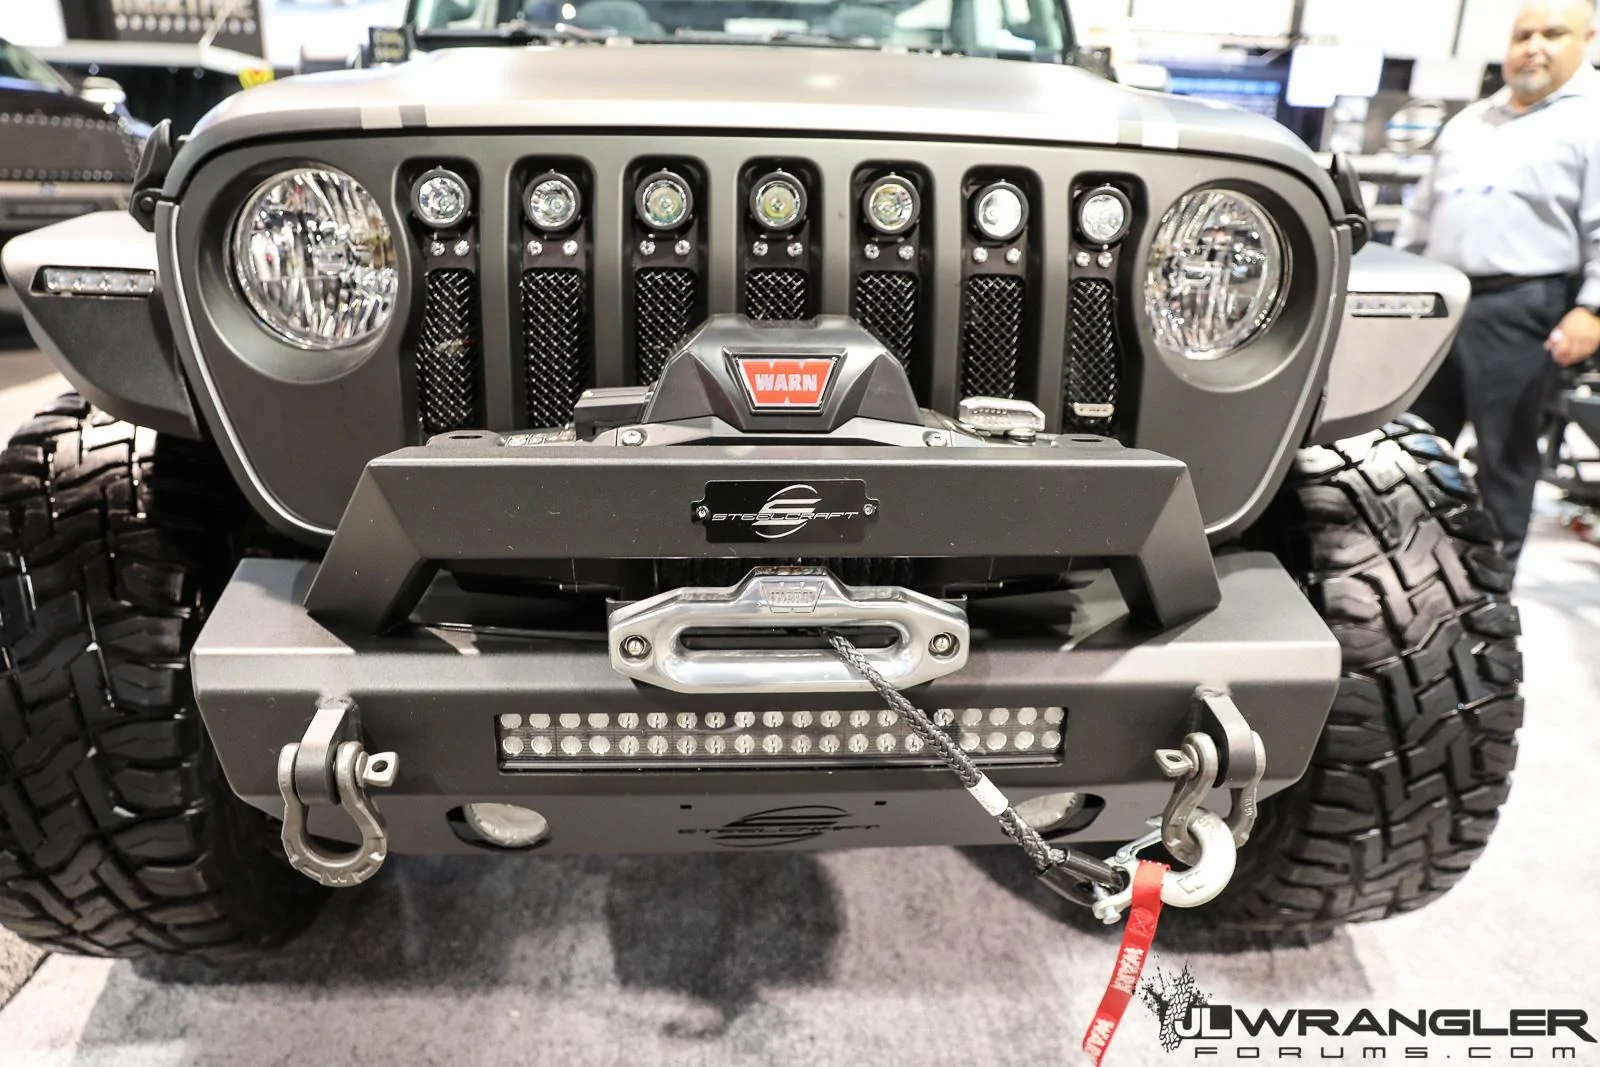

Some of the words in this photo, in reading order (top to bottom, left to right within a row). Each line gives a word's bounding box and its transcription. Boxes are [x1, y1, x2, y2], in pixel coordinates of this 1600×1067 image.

[754, 373, 818, 392] WARN
[711, 511, 859, 522] STEELCRAFT
[1111, 947, 1145, 995] WARN
[1084, 1017, 1116, 1065] WAR
